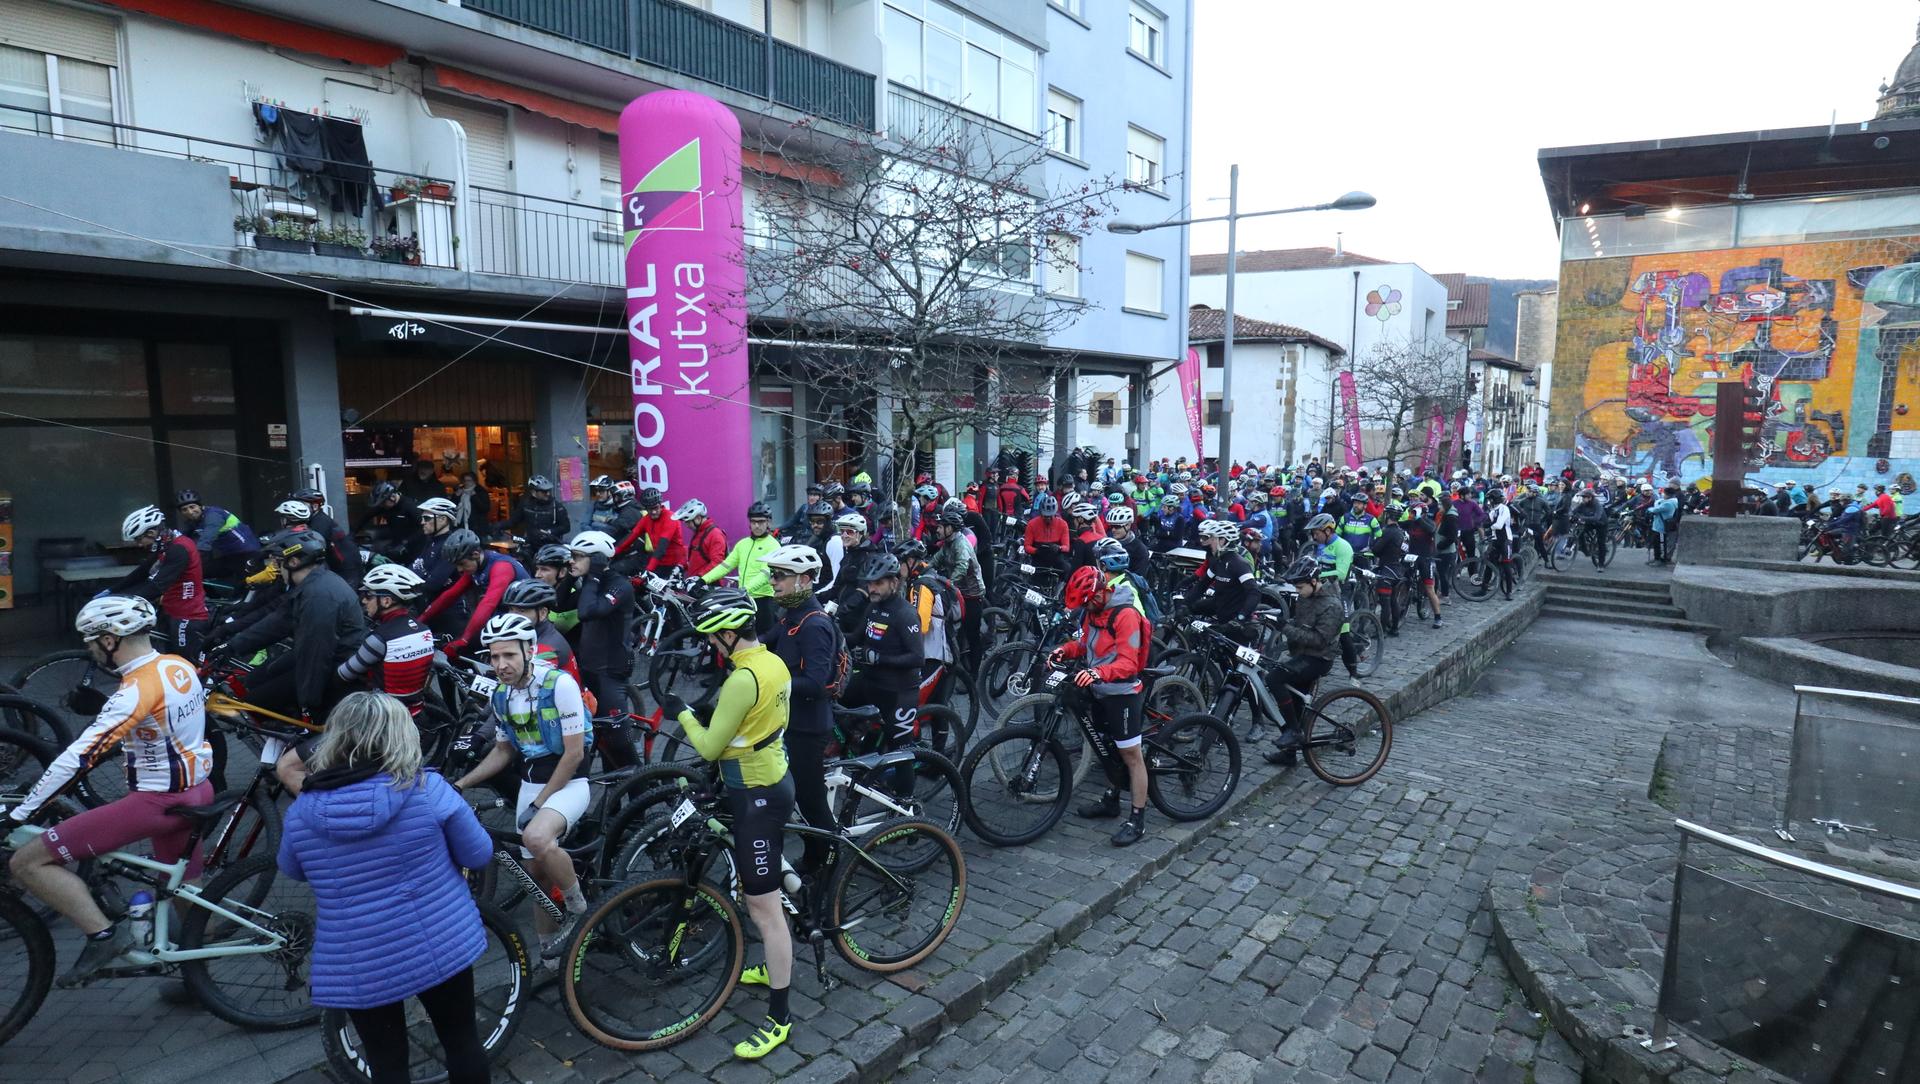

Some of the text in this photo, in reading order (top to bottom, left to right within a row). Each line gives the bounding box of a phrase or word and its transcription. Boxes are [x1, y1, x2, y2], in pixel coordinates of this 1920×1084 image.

[389, 320, 425, 340] 18/70
[671, 262, 710, 395] kutxa
[627, 263, 671, 510] BORAL
[1242, 650, 1255, 663] 15
[753, 839, 769, 876] ORIO
[509, 933, 527, 977] MAXXIS
